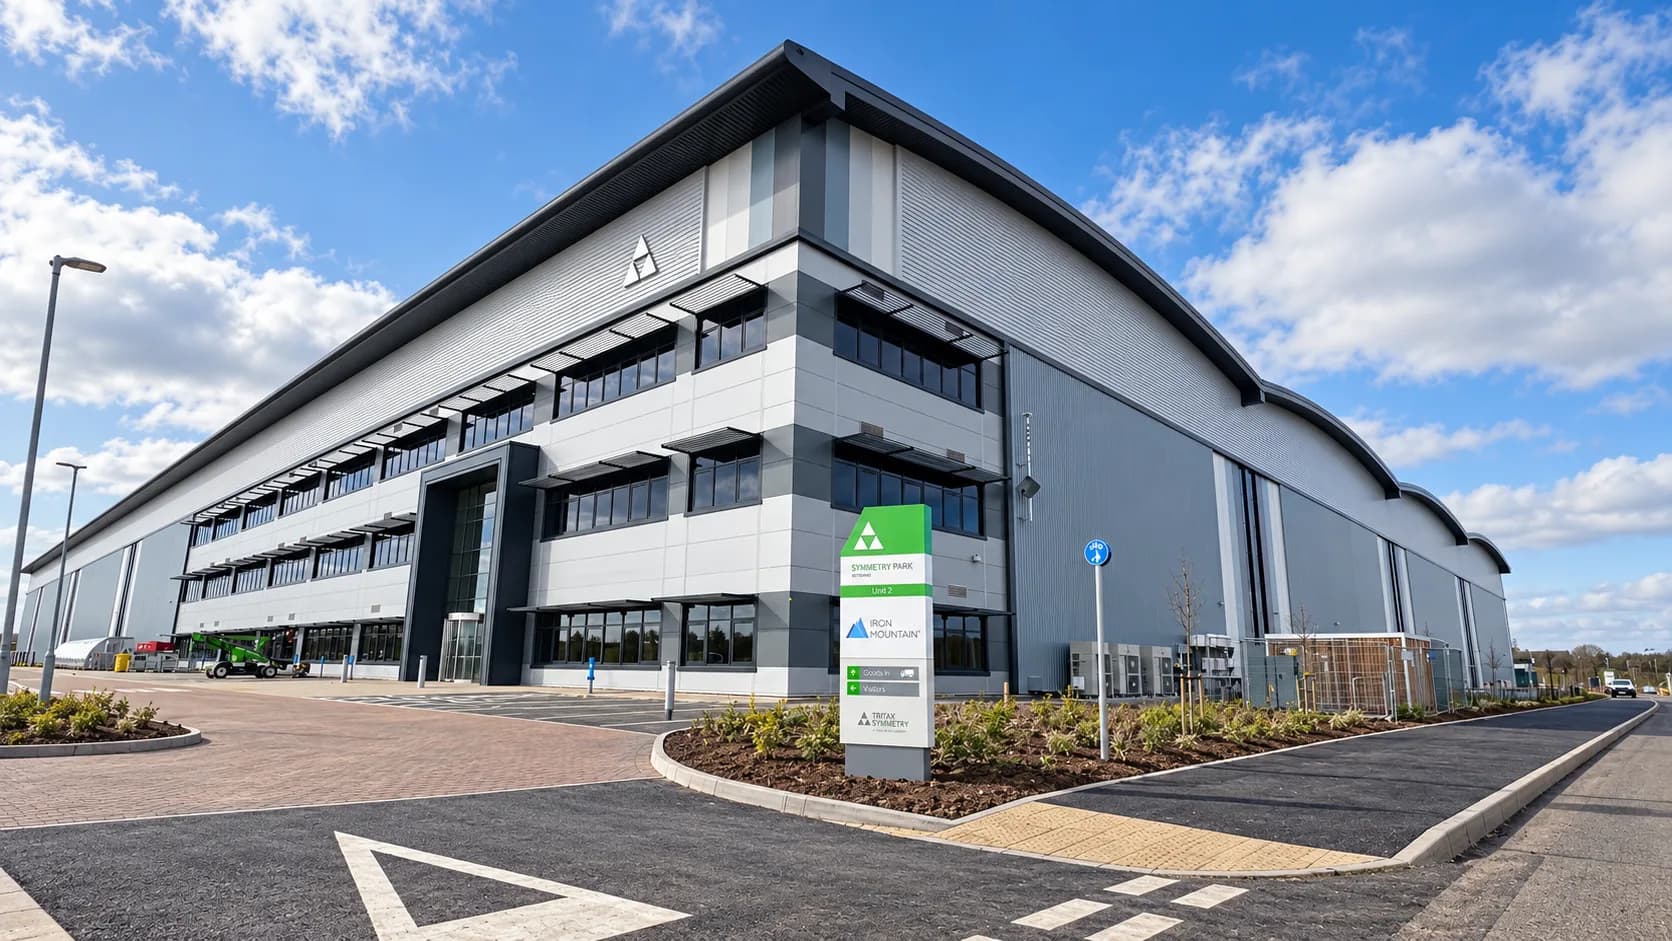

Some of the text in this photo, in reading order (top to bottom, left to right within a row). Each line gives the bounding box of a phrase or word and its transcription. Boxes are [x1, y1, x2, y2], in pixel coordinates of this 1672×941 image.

[852, 562, 913, 572] SYMMETRY PARK
[872, 586, 893, 595] Unit 2
[870, 619, 892, 628] IRON
[872, 720, 909, 728] SYMMETRY
